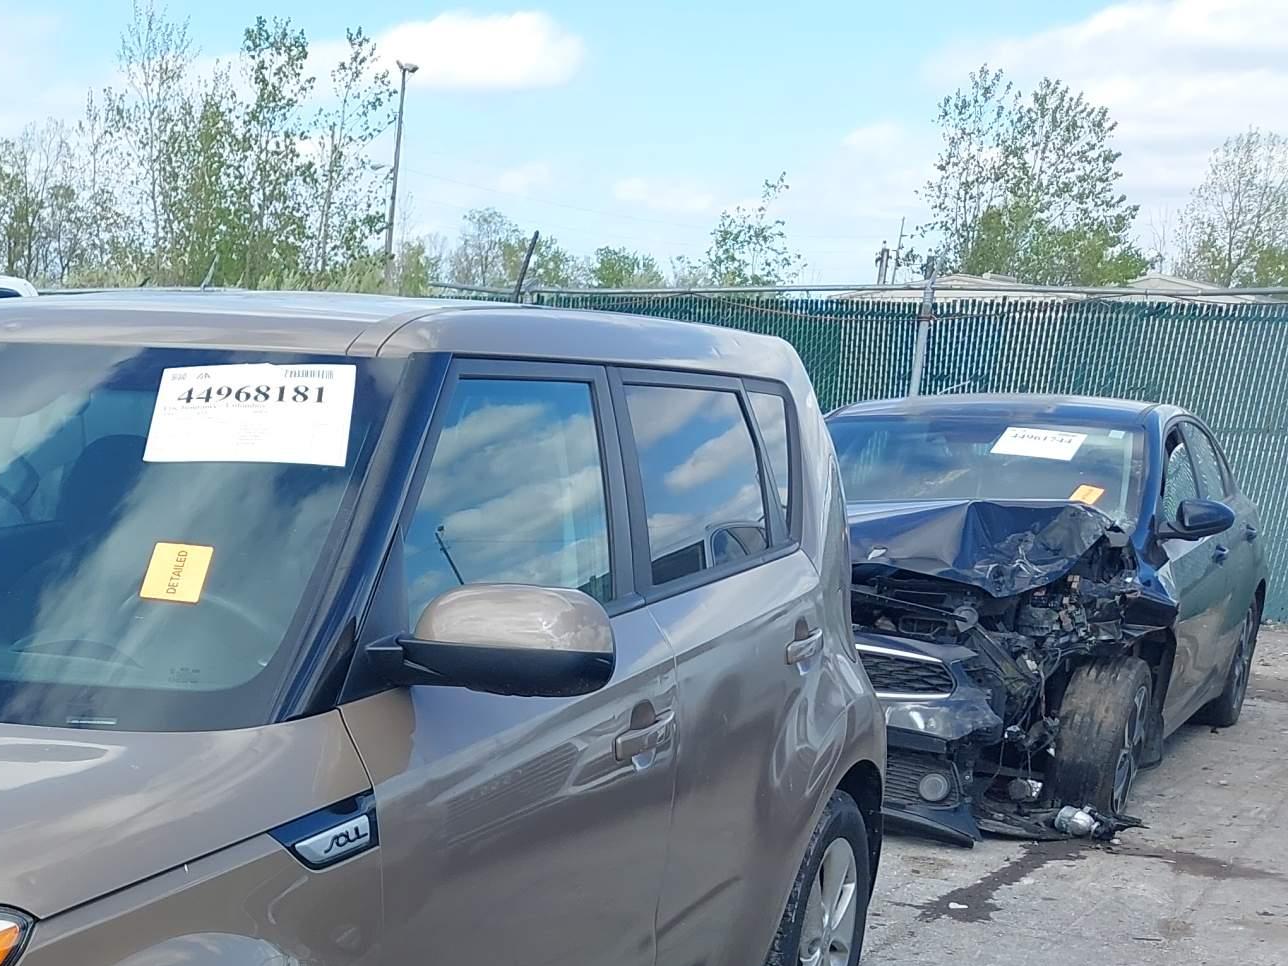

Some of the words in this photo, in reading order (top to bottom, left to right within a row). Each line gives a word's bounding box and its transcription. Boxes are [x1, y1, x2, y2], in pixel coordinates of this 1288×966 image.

[177, 384, 325, 404] 44968181
[166, 550, 188, 594] DETAILED
[324, 826, 369, 855] SOUL
